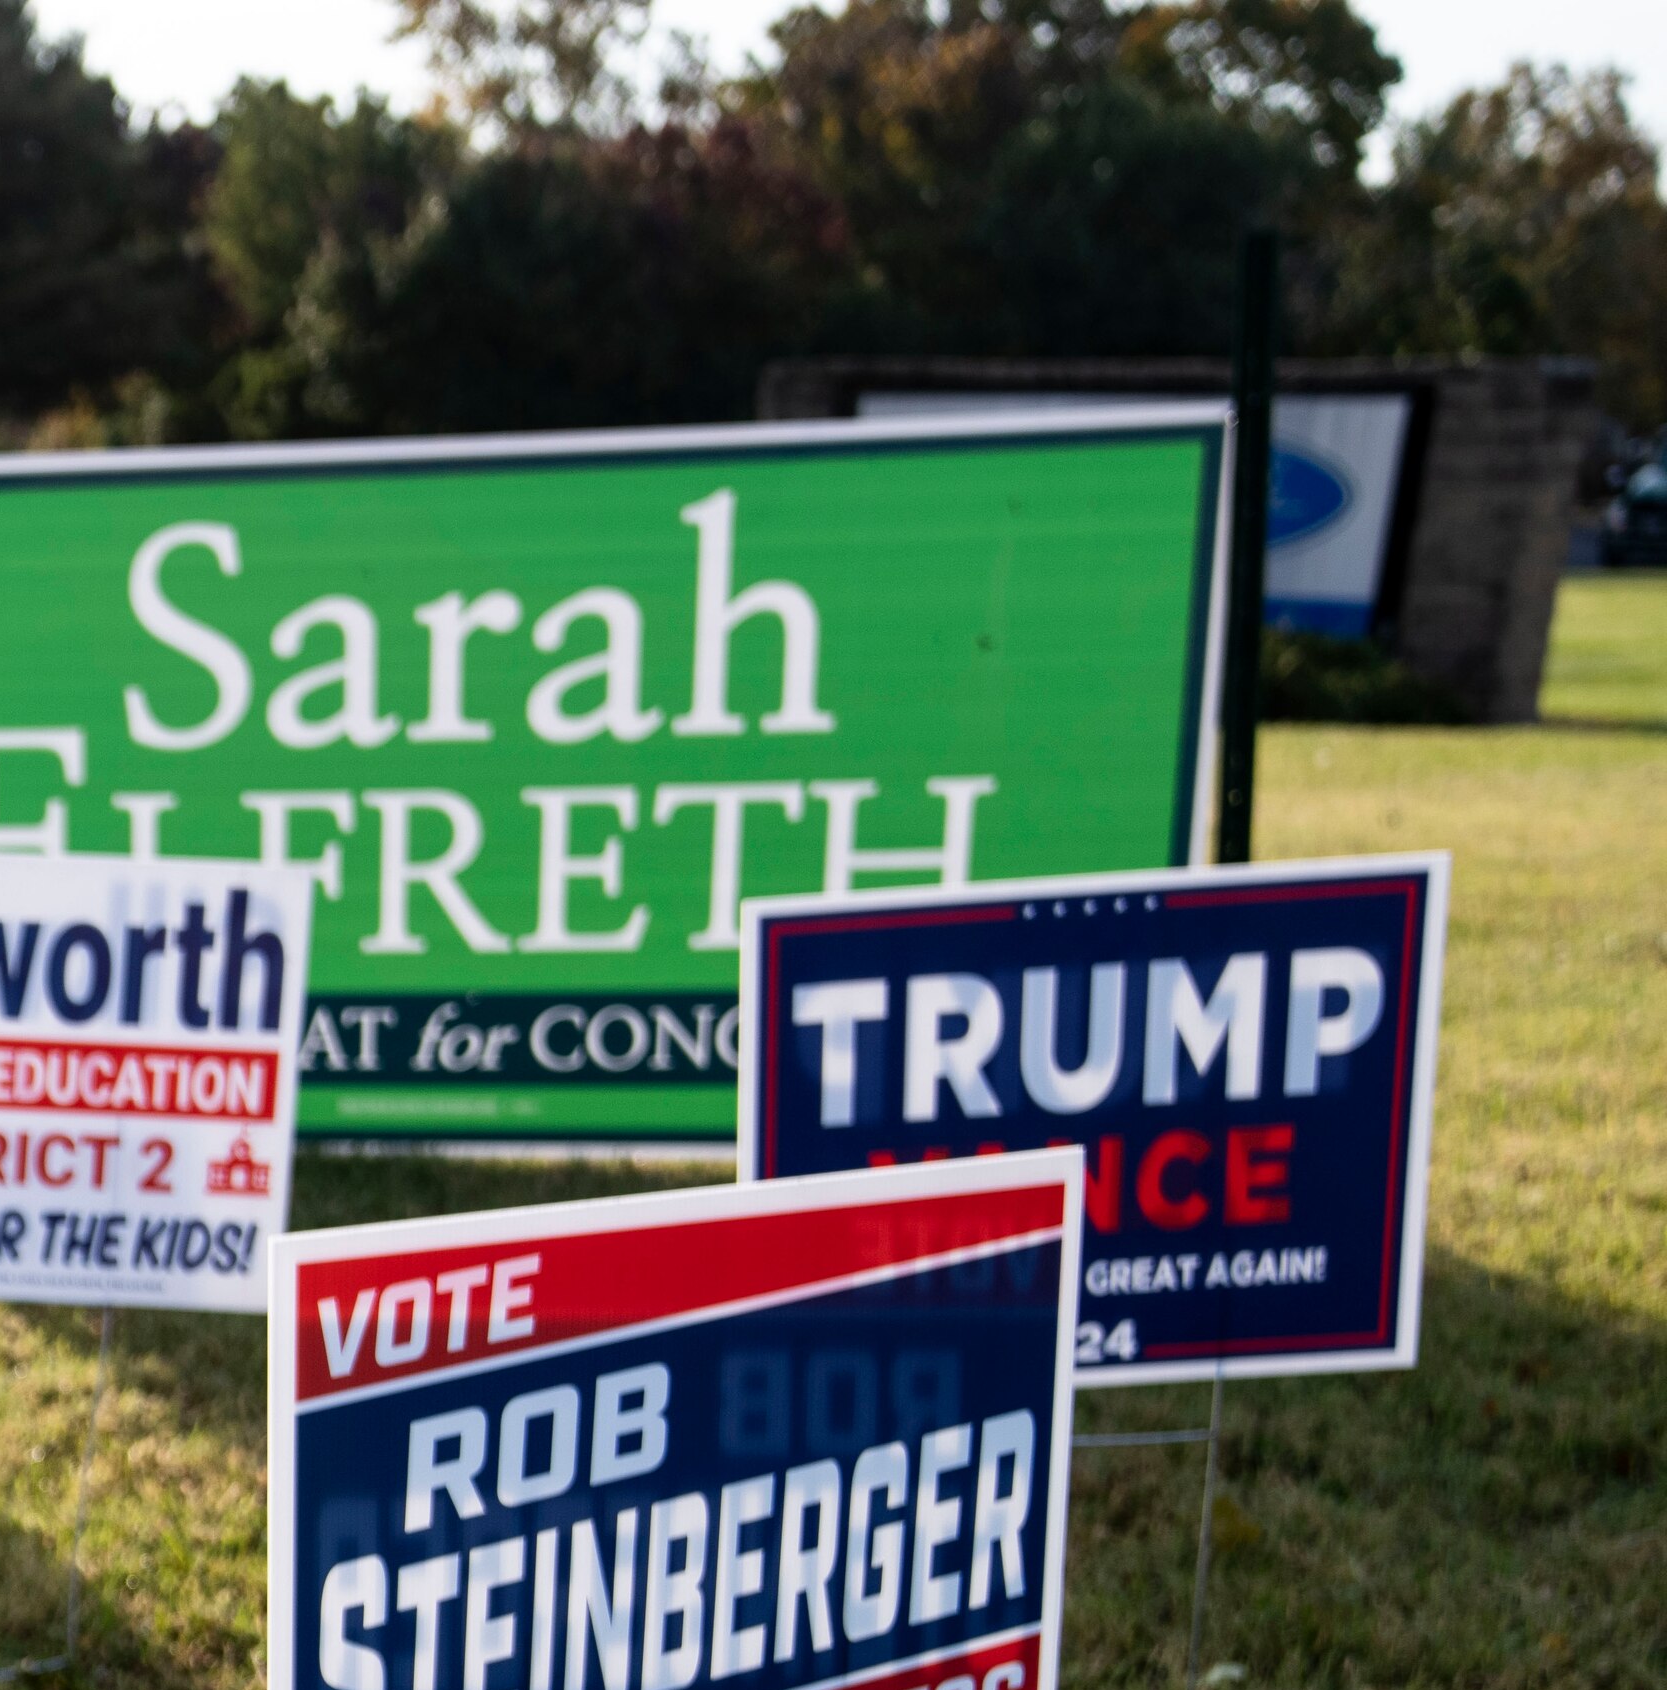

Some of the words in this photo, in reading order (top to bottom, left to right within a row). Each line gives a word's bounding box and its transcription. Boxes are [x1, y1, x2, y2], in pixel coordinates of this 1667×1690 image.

[123, 488, 837, 750] Sarah
[410, 1001, 520, 1073] for
[792, 946, 1385, 1128] TRUMP
[138, 1138, 175, 1193] 2
[39, 1212, 125, 1267] THE
[133, 1217, 259, 1275] KIDS!
[1084, 1253, 1201, 1296] GREAT
[1205, 1246, 1327, 1289] AGAIN!
[318, 1251, 542, 1379] VOTE
[404, 1361, 671, 1535] ROB
